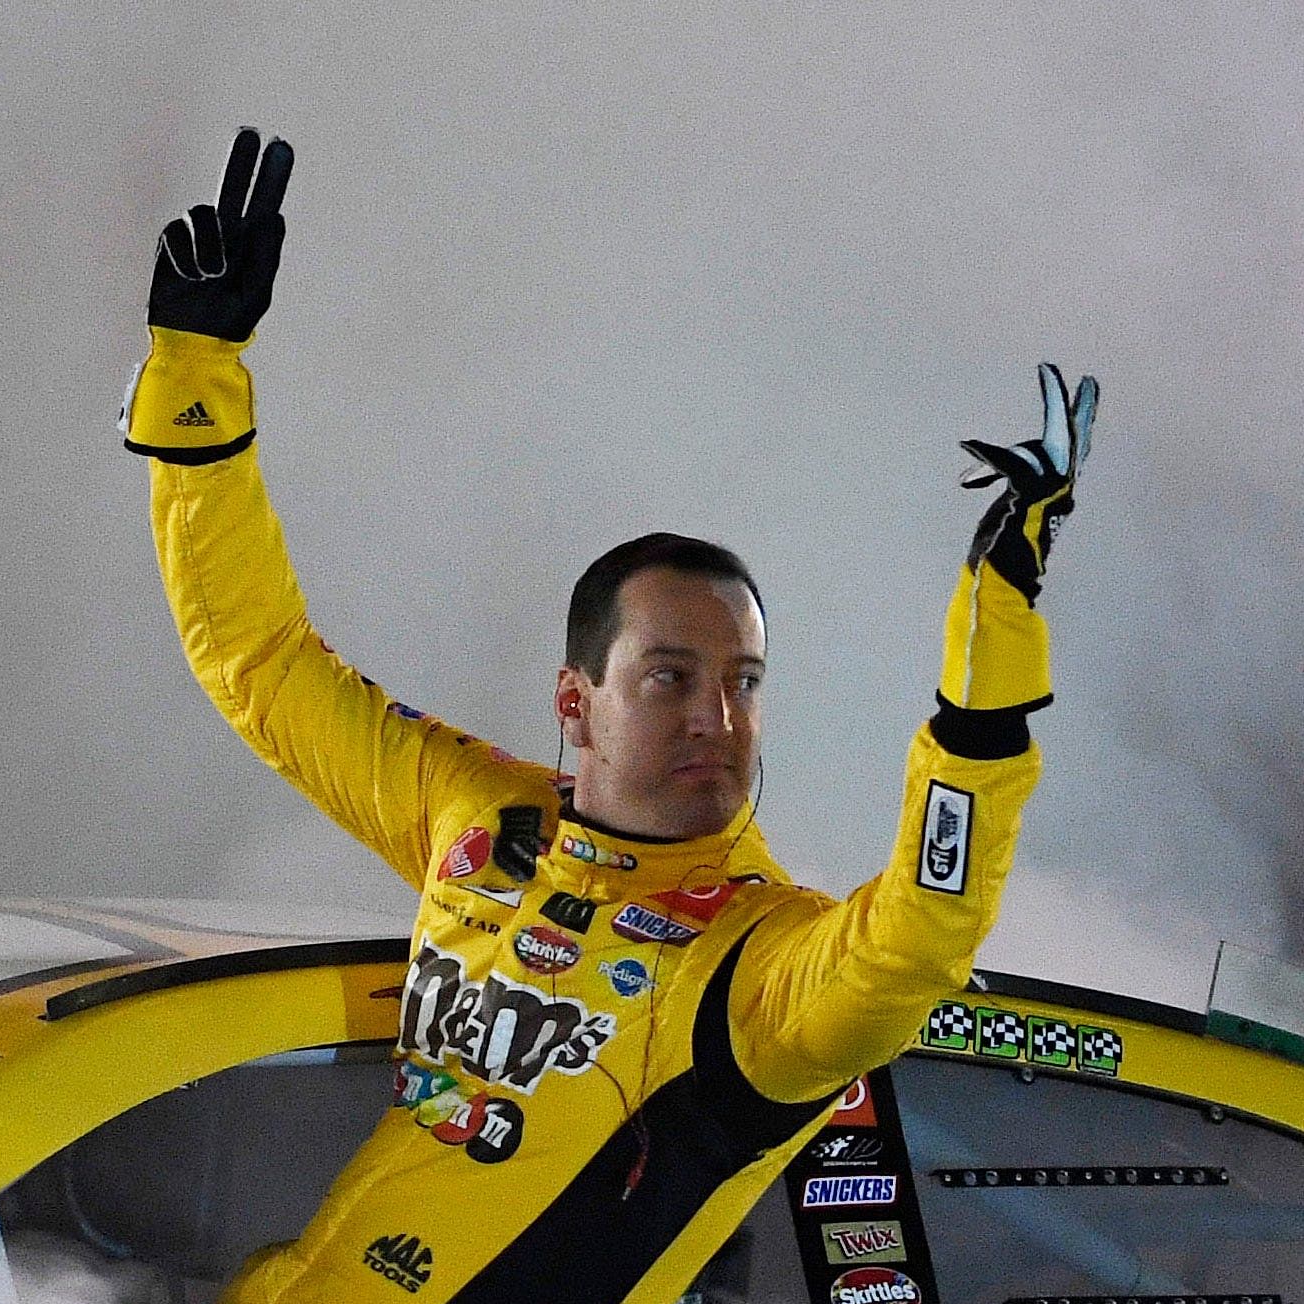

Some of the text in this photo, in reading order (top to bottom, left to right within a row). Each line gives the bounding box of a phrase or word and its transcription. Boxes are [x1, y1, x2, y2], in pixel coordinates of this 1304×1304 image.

[806, 1178, 895, 1205] SNICKERS
[365, 1233, 433, 1283] MAC
[830, 1225, 900, 1257] Twix
[363, 1252, 420, 1294] TOOLS
